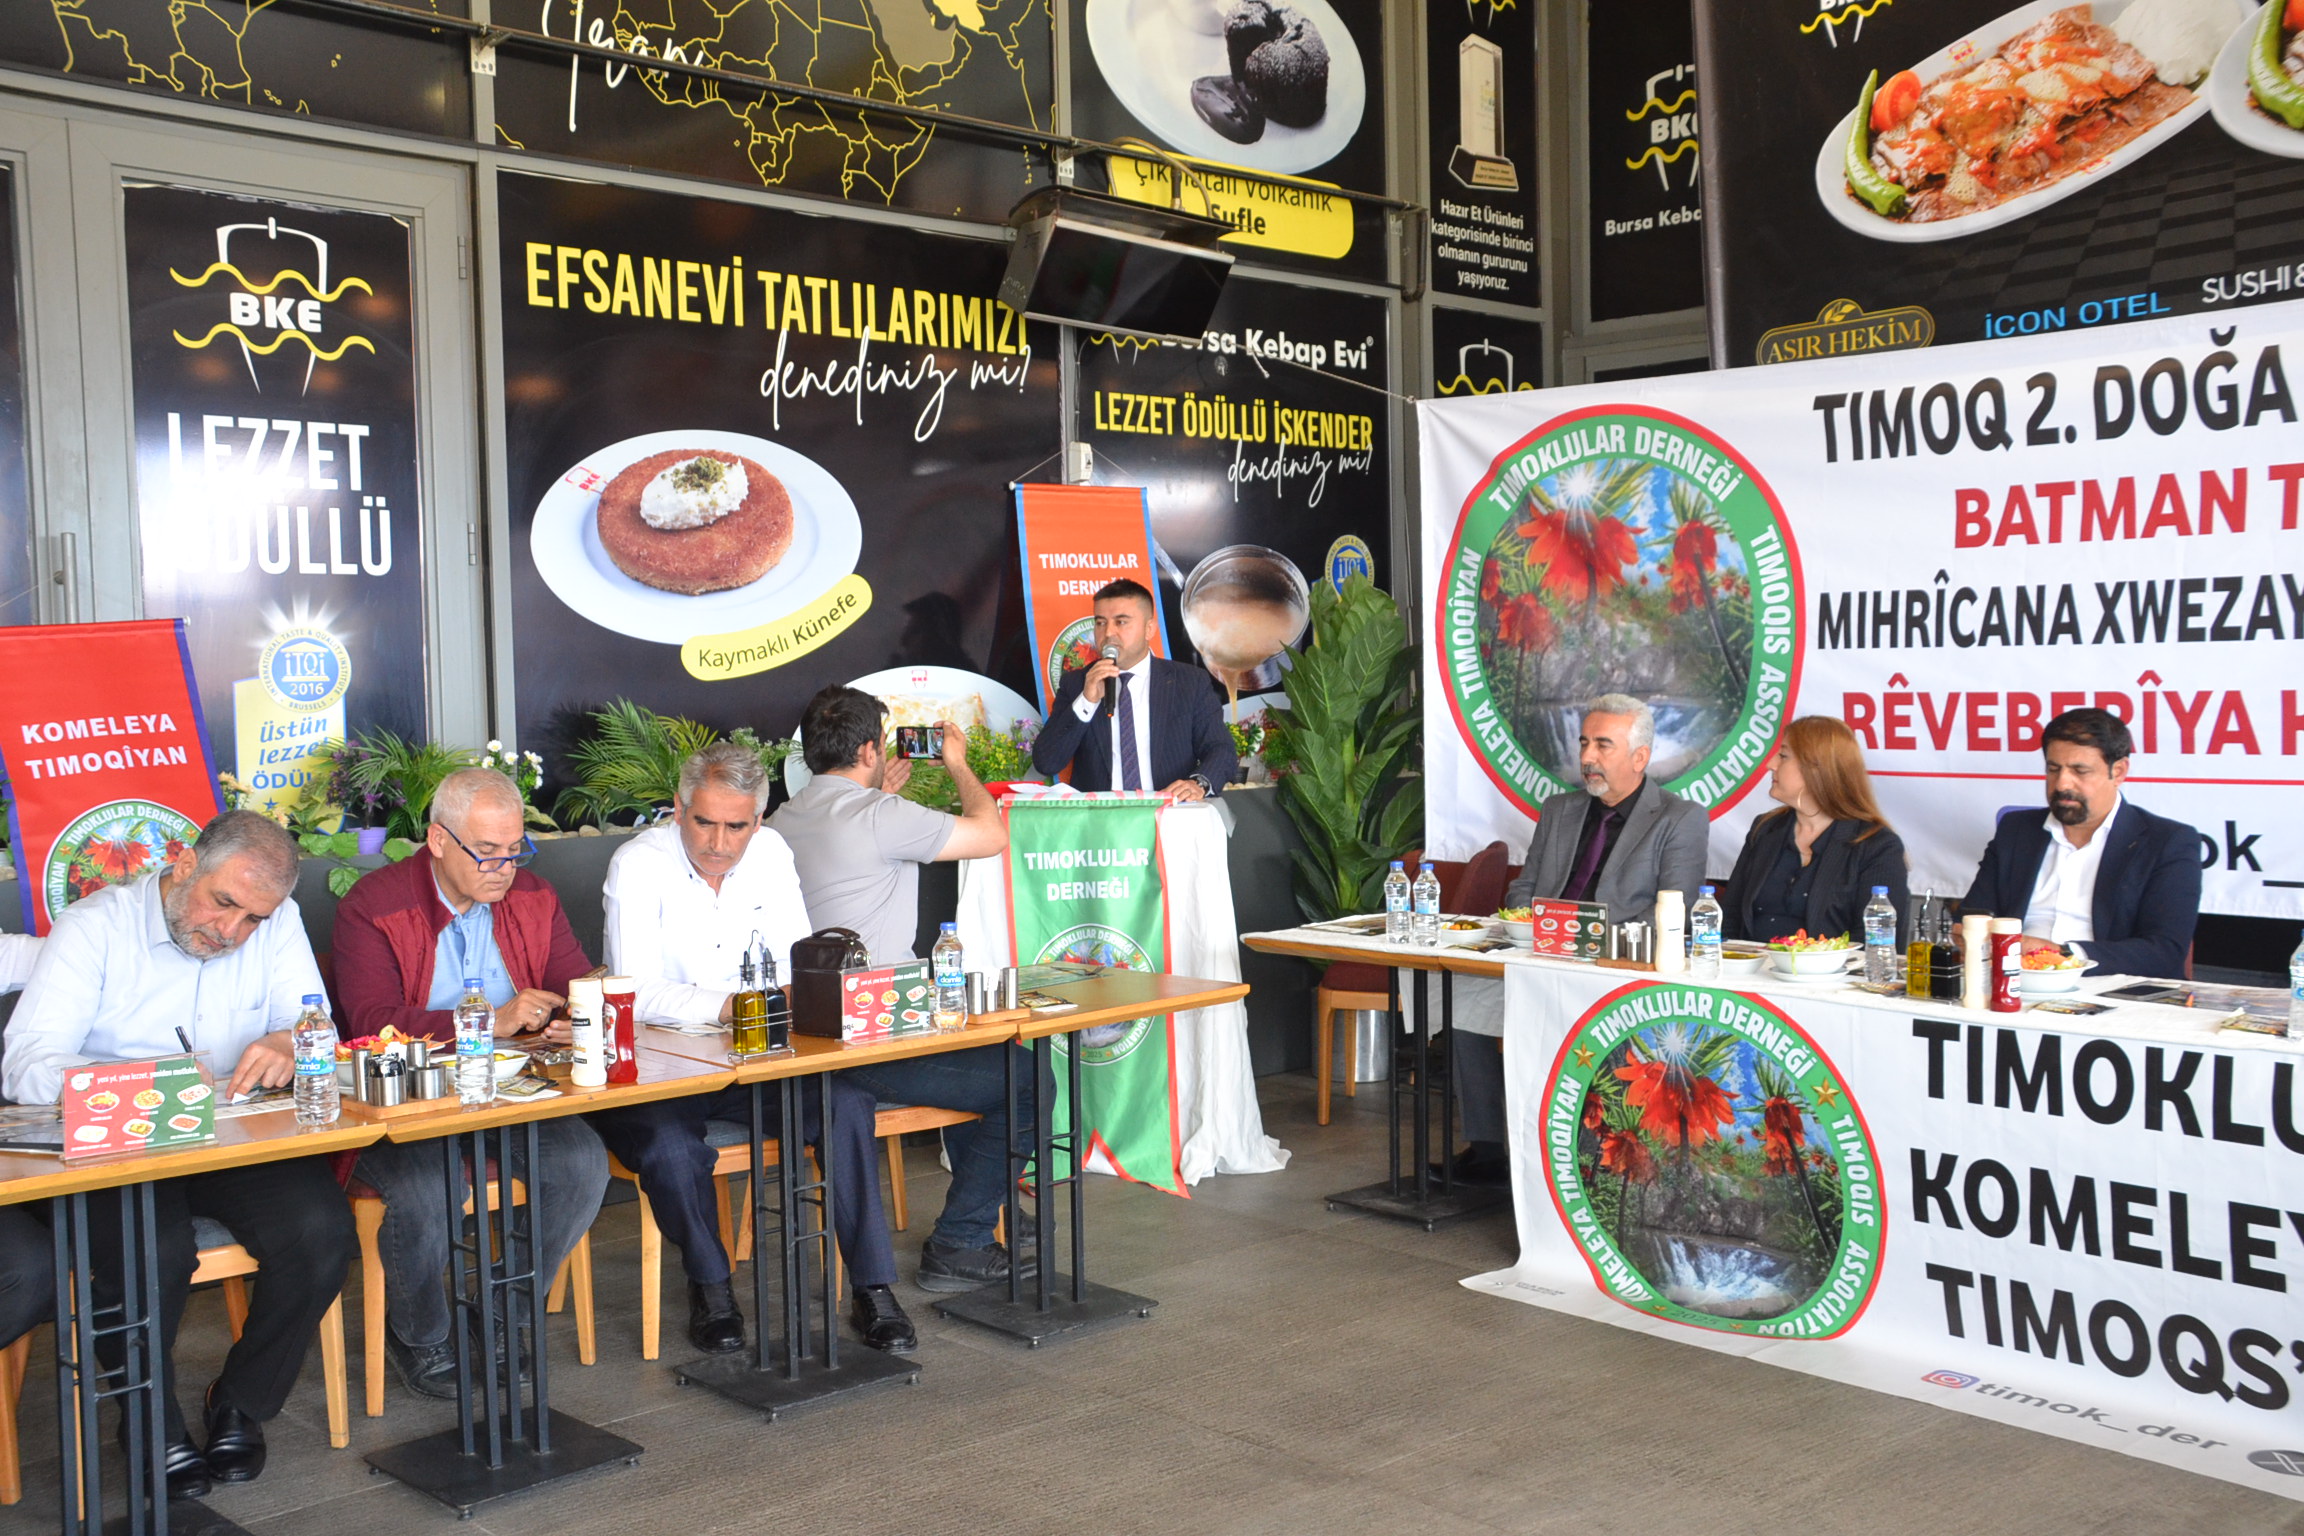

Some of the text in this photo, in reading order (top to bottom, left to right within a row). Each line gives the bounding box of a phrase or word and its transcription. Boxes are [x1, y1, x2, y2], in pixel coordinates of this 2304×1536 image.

[1431, 218, 1534, 253] kategorisinde birinci
[1441, 198, 1524, 230] Hazır Et Ürünleri
[1605, 204, 1702, 236] Bursa Keba
[1438, 242, 1528, 273] olmanın gururunu
[525, 241, 1028, 357] EFSANEVİ TATLILARIMIZI
[1457, 270, 1510, 291] yaşıyoruz.
[2202, 265, 2291, 303] SUSHI
[229, 292, 322, 333] BKE
[1984, 291, 2171, 339] İCON OTEL
[1246, 328, 1326, 370] Kebap
[1767, 318, 1922, 364] ASIR HEKİM
[760, 326, 1032, 443] denediniz mi?
[1812, 325, 2299, 463] TIMOQ 2. DOĞA
[1095, 391, 1373, 450] LEZZET ÖDÜLLÜ İSKENDER
[167, 412, 370, 491] LEZZET
[1228, 436, 1373, 508] denediniz mi?
[1489, 424, 1744, 513] TIMOKLULAR DERNEĞİ
[1954, 467, 2248, 549] BATMAN
[1038, 553, 1139, 569] TIMOKLULAR
[1448, 546, 1482, 699] TIMOQÎYAN
[1817, 568, 2083, 650] MIHRÎCANA
[281, 628, 305, 641] TASTE
[315, 631, 344, 655] QUALITY
[699, 593, 857, 672] Kaymaklı Künefe
[1674, 524, 1791, 808] TIMOQIS ASSOCIATIO
[289, 683, 325, 695] 2016
[21, 713, 177, 745] KOMELEYA
[24, 745, 188, 779] TIMOQÎYAN
[259, 737, 328, 766] lezze
[66, 805, 187, 846] TIMOKLULAR DERNEĞİ
[1023, 848, 1150, 870] TIMOKLULAR
[1046, 876, 1130, 902] DERNEĞİ
[1048, 929, 1135, 957] TIMOKLULAR DERNEĞİ
[1590, 990, 1818, 1080] TIMOKLULAR DERNEĞİ
[1547, 1074, 1654, 1303] KOMELEYA TIMOQÎYAN
[1758, 1114, 1875, 1336] TIMOQIS ASSOCIATION
[1975, 1383, 2229, 1449] timok_der
